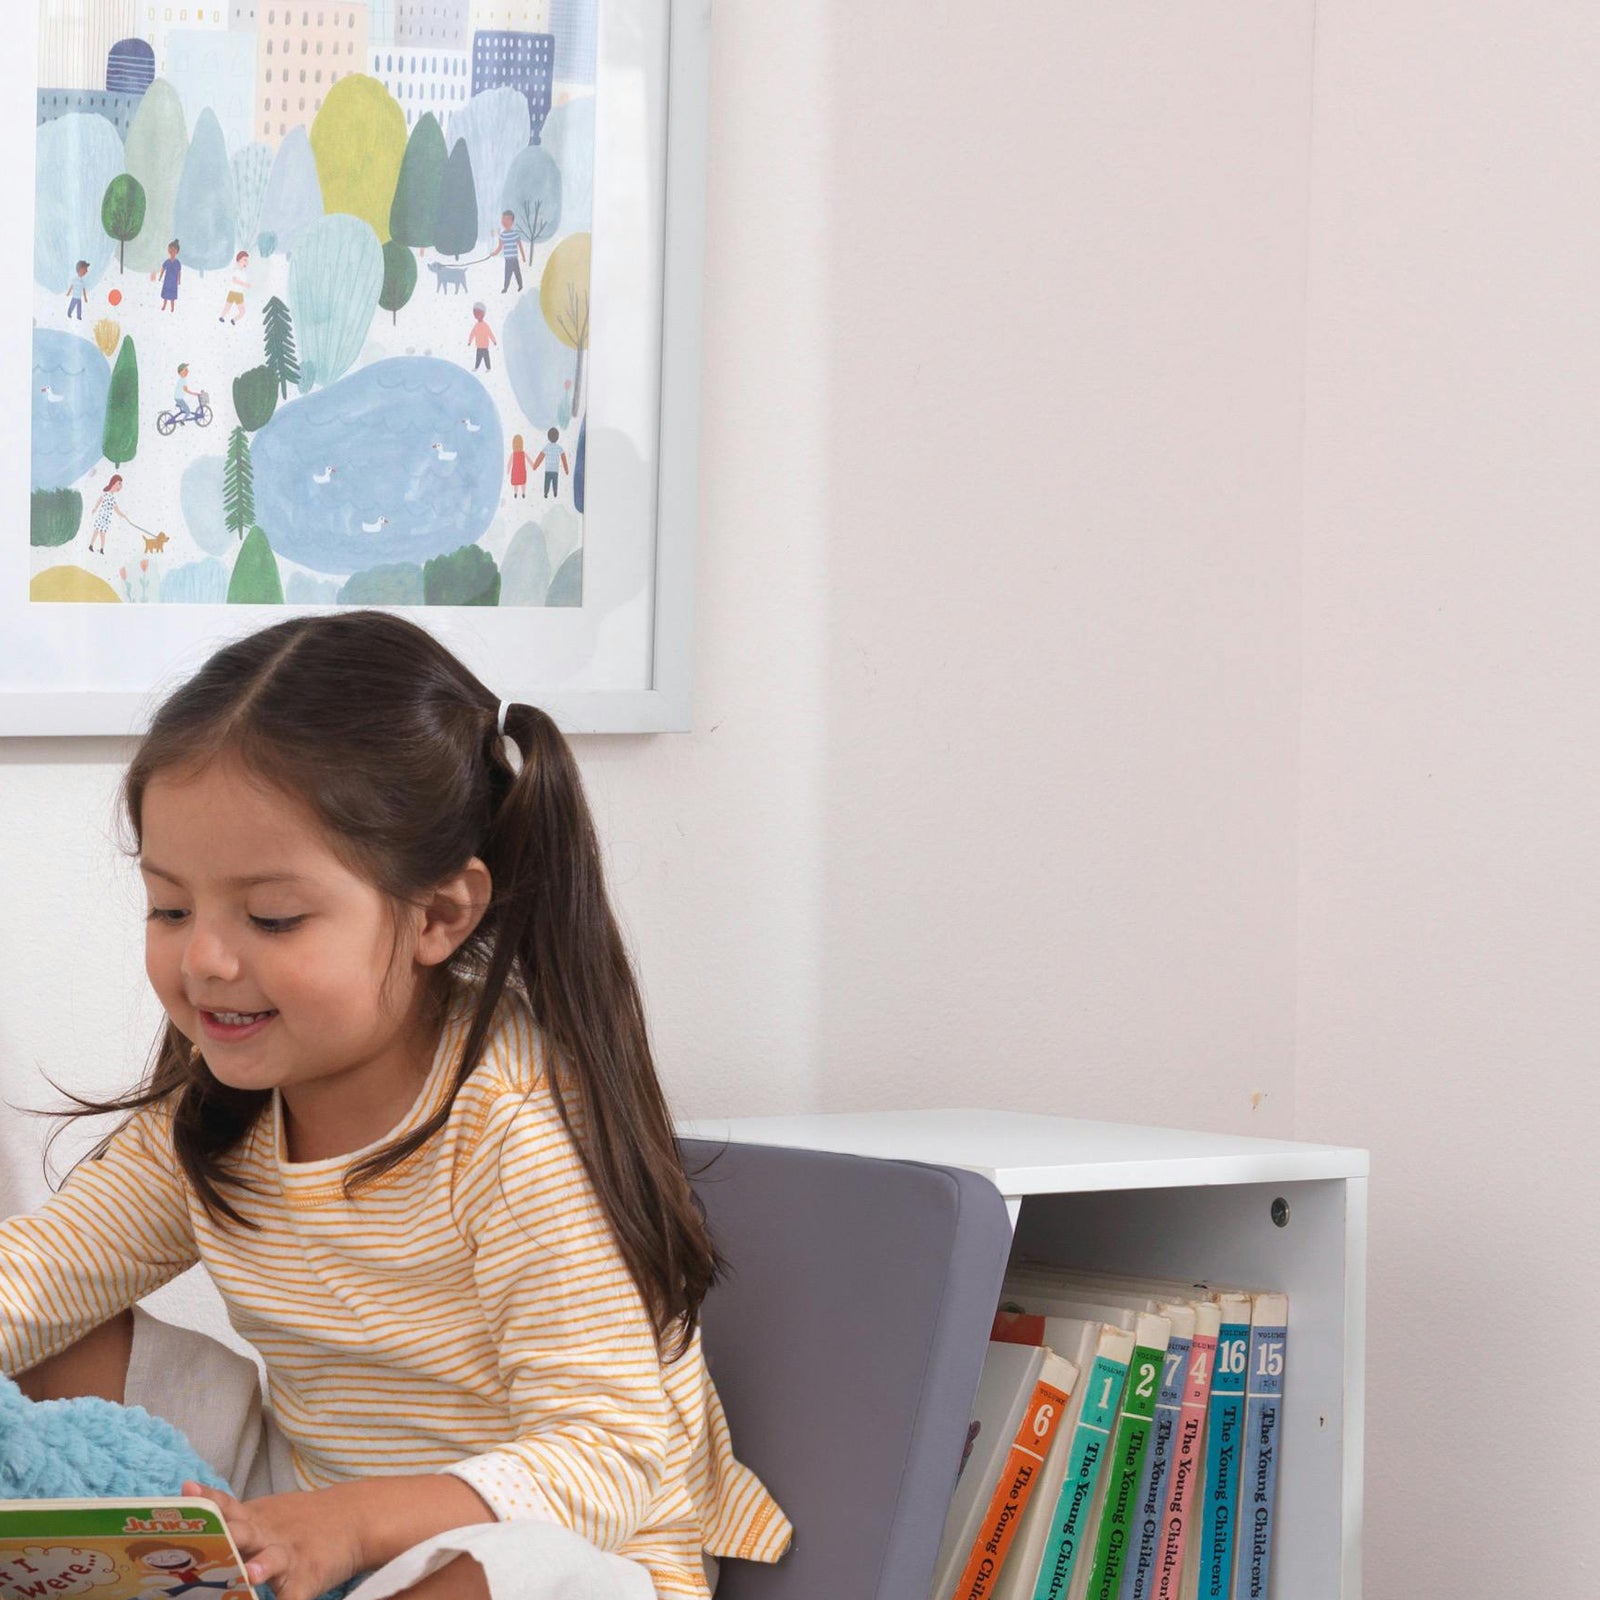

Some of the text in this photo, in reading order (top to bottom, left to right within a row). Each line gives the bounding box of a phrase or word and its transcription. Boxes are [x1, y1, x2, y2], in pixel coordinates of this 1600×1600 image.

[1165, 1354, 1183, 1387] 7
[1189, 1352, 1208, 1385] 4
[1218, 1340, 1246, 1374] 16
[1256, 1342, 1284, 1376] 15
[1097, 1377, 1113, 1409] 1
[1135, 1363, 1156, 1397] 2
[1033, 1404, 1054, 1437] 6
[1155, 1420, 1172, 1456] The
[1181, 1419, 1199, 1454] The
[1221, 1406, 1237, 1442] The
[1260, 1408, 1276, 1445] The
[1080, 1442, 1100, 1478] The
[1126, 1430, 1144, 1466] The
[1010, 1466, 1033, 1499] The
[1144, 1459, 1166, 1514] Young
[1170, 1458, 1193, 1513] Young
[1214, 1446, 1233, 1501] Young
[1254, 1448, 1272, 1503] Young
[1063, 1481, 1091, 1536] Young
[1112, 1470, 1136, 1524] Young
[986, 1503, 1018, 1555] Young
[12, 1558, 39, 1574] I
[1211, 1506, 1229, 1597] Children's
[1251, 1507, 1268, 1598] Children's
